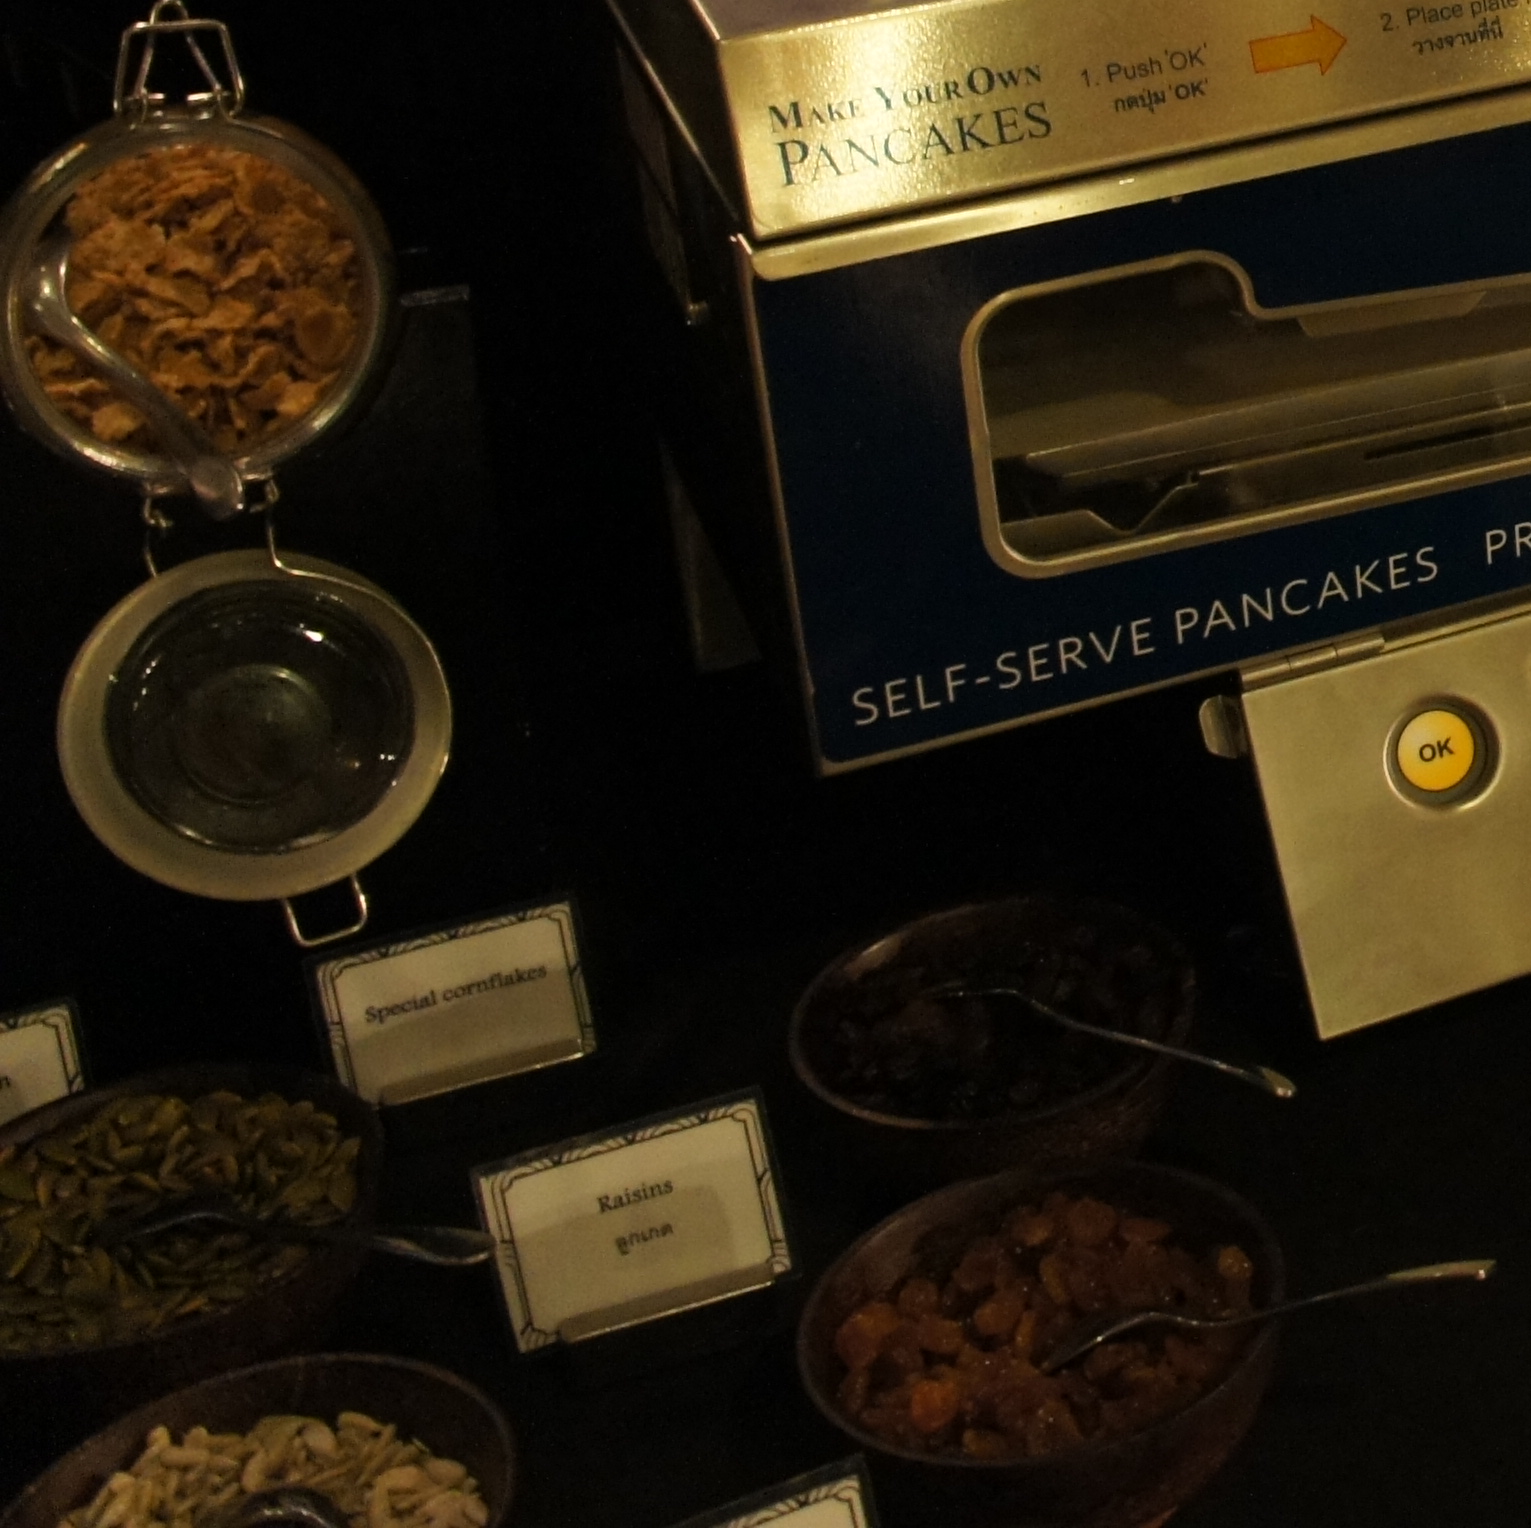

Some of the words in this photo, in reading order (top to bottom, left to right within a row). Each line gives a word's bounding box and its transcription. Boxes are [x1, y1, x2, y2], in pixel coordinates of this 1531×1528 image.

[1379, 12, 1400, 32] 2.
[1405, 3, 1464, 26] Place
[1080, 68, 1100, 88] 1.
[1105, 56, 1163, 83] Push
[767, 99, 865, 134] MAKE
[873, 80, 963, 113] YOUR
[966, 64, 1043, 96] OWN
[775, 100, 1053, 187] PANCAKES
[852, 617, 1156, 728] SELF-SERVE
[1174, 546, 1441, 647] PANCAKES
[1418, 737, 1456, 763] OK
[364, 989, 438, 1025] Special
[442, 964, 549, 1003] cornflakes
[596, 1179, 674, 1214] Raisins
